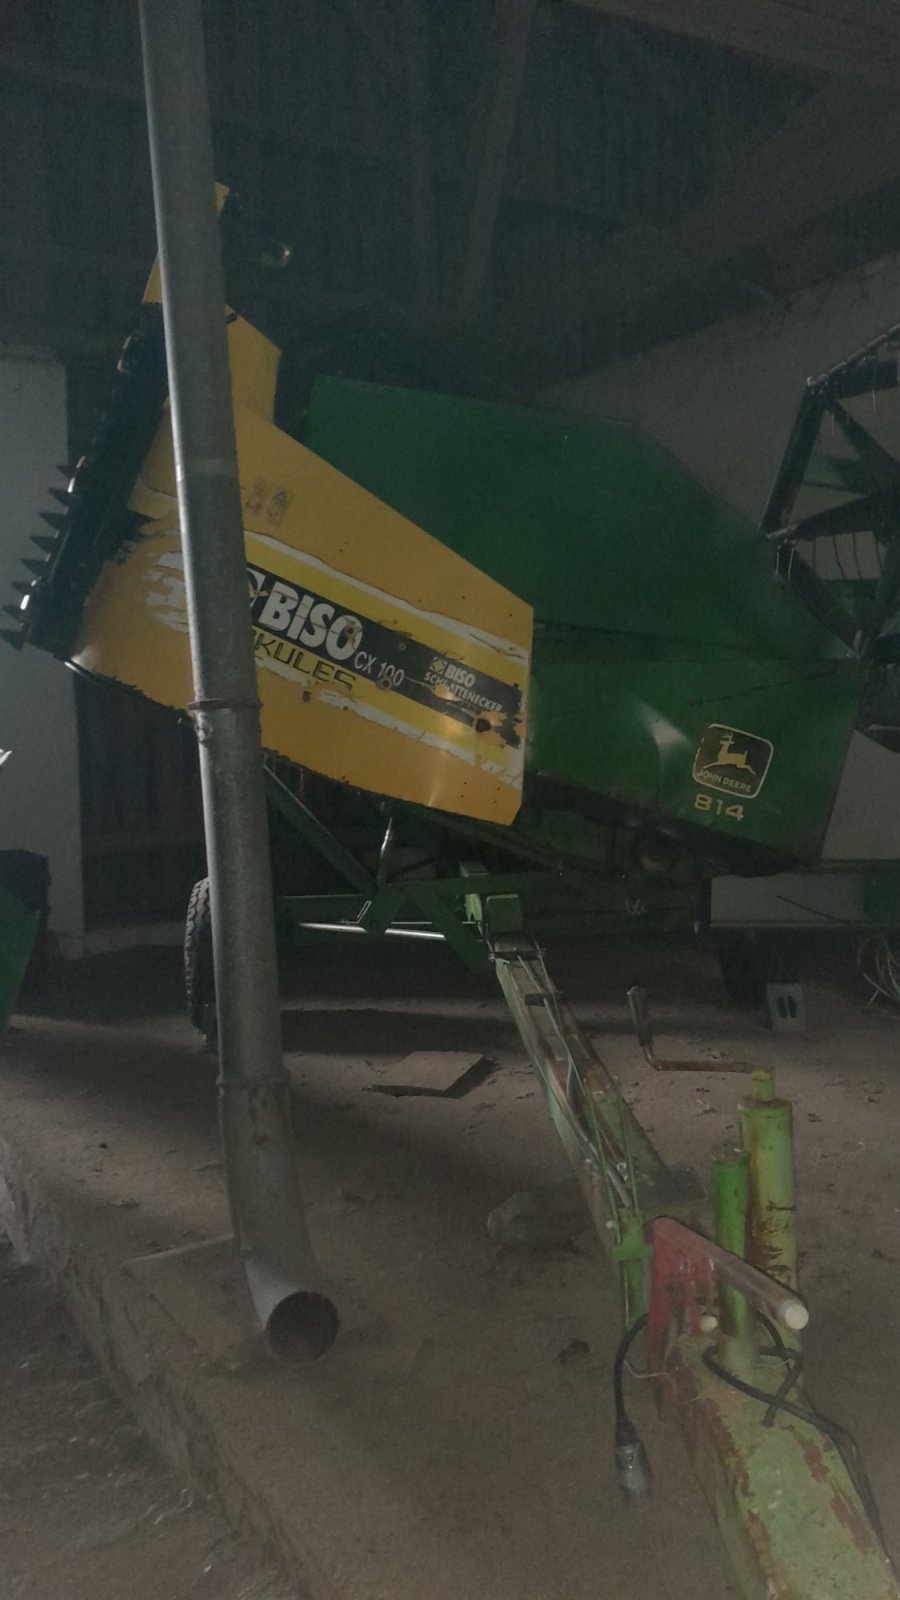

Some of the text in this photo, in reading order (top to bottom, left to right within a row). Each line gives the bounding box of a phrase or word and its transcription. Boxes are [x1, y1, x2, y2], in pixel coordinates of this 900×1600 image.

[258, 581, 405, 687] BISO CX 100
[252, 629, 356, 690] KULES
[444, 663, 476, 688] BISO
[722, 777, 753, 793] DEERE
[694, 793, 744, 822] 814
